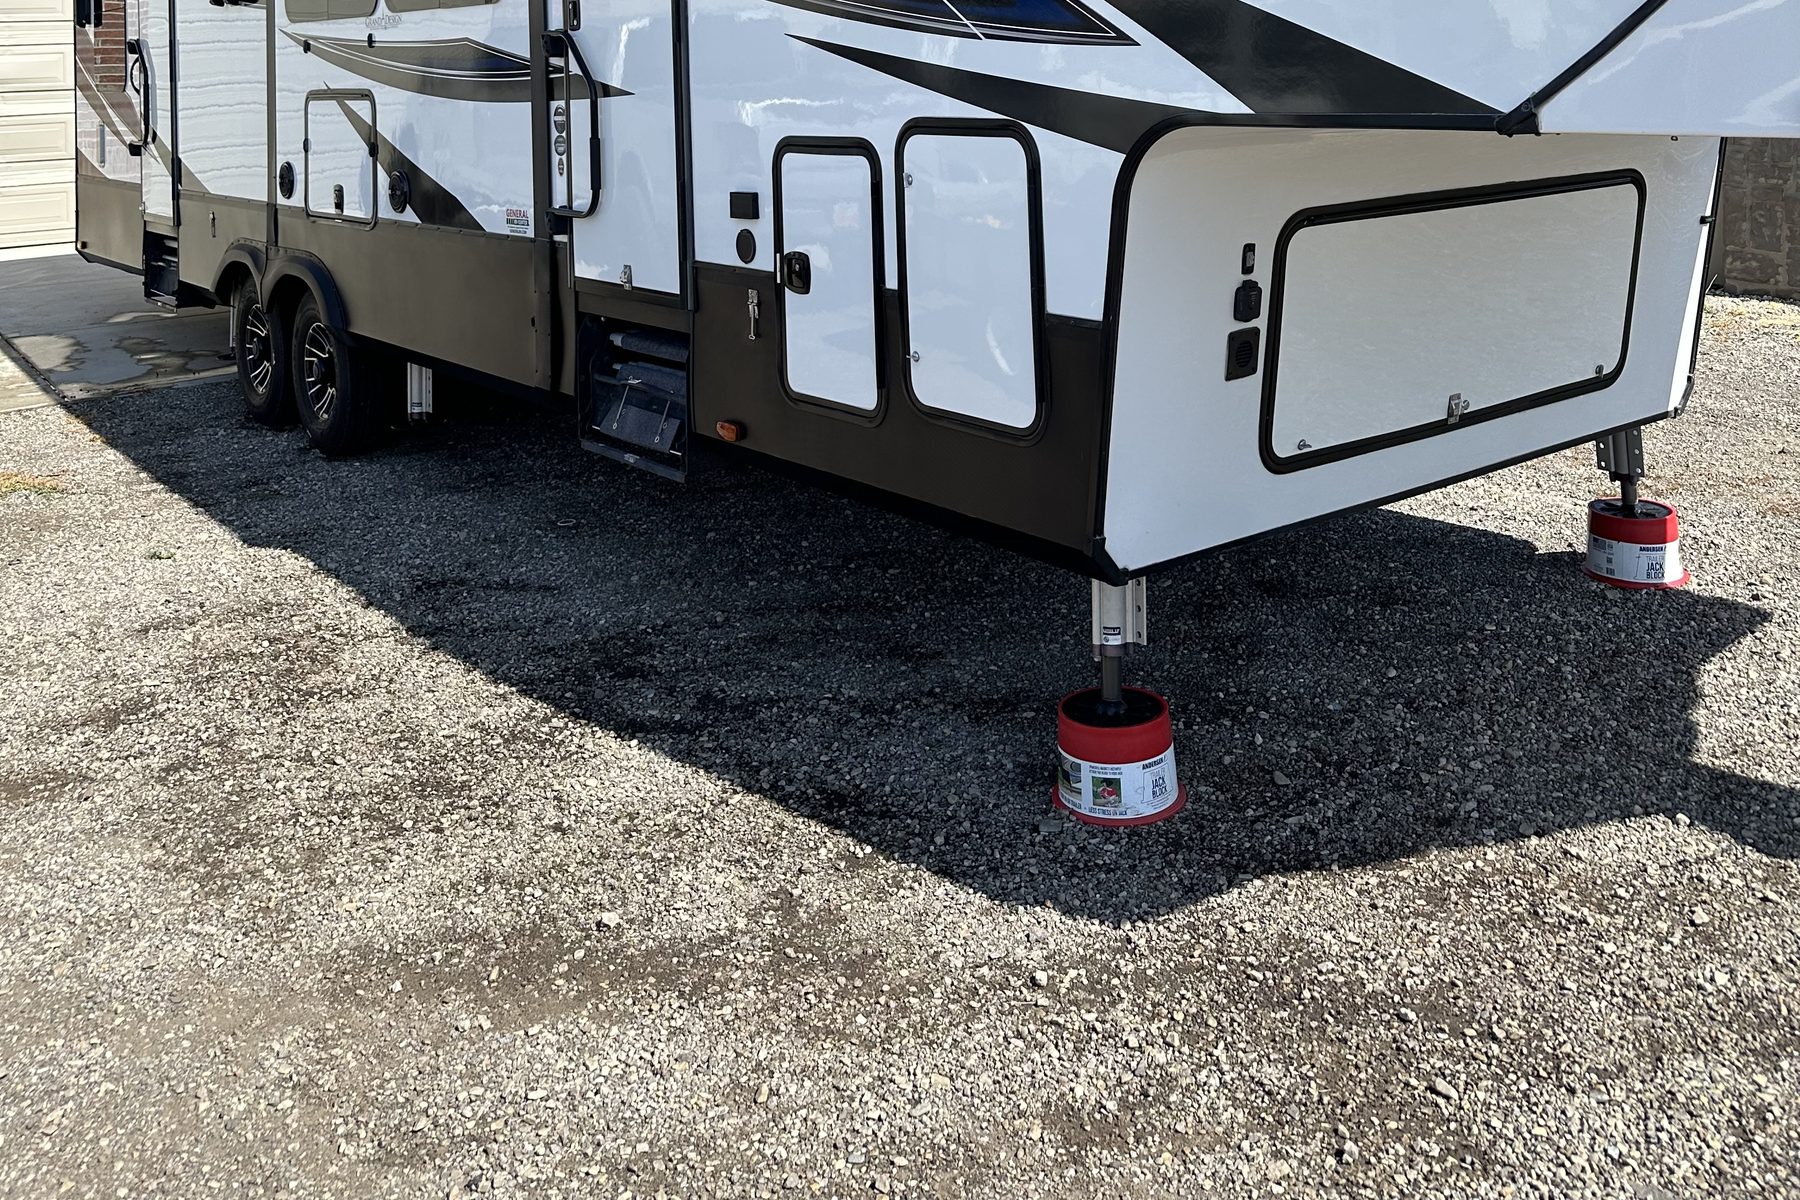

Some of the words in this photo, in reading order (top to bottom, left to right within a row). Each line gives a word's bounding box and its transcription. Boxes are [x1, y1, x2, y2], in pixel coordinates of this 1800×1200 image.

[505, 208, 529, 219] GENERAL
[1639, 545, 1664, 553] ANDERSEN
[1646, 562, 1665, 572] JACK
[1646, 571, 1665, 580] BLOCK
[1141, 756, 1164, 771] ANDERSEN
[1151, 776, 1166, 790] JACK
[1151, 786, 1168, 799] BLOCK
